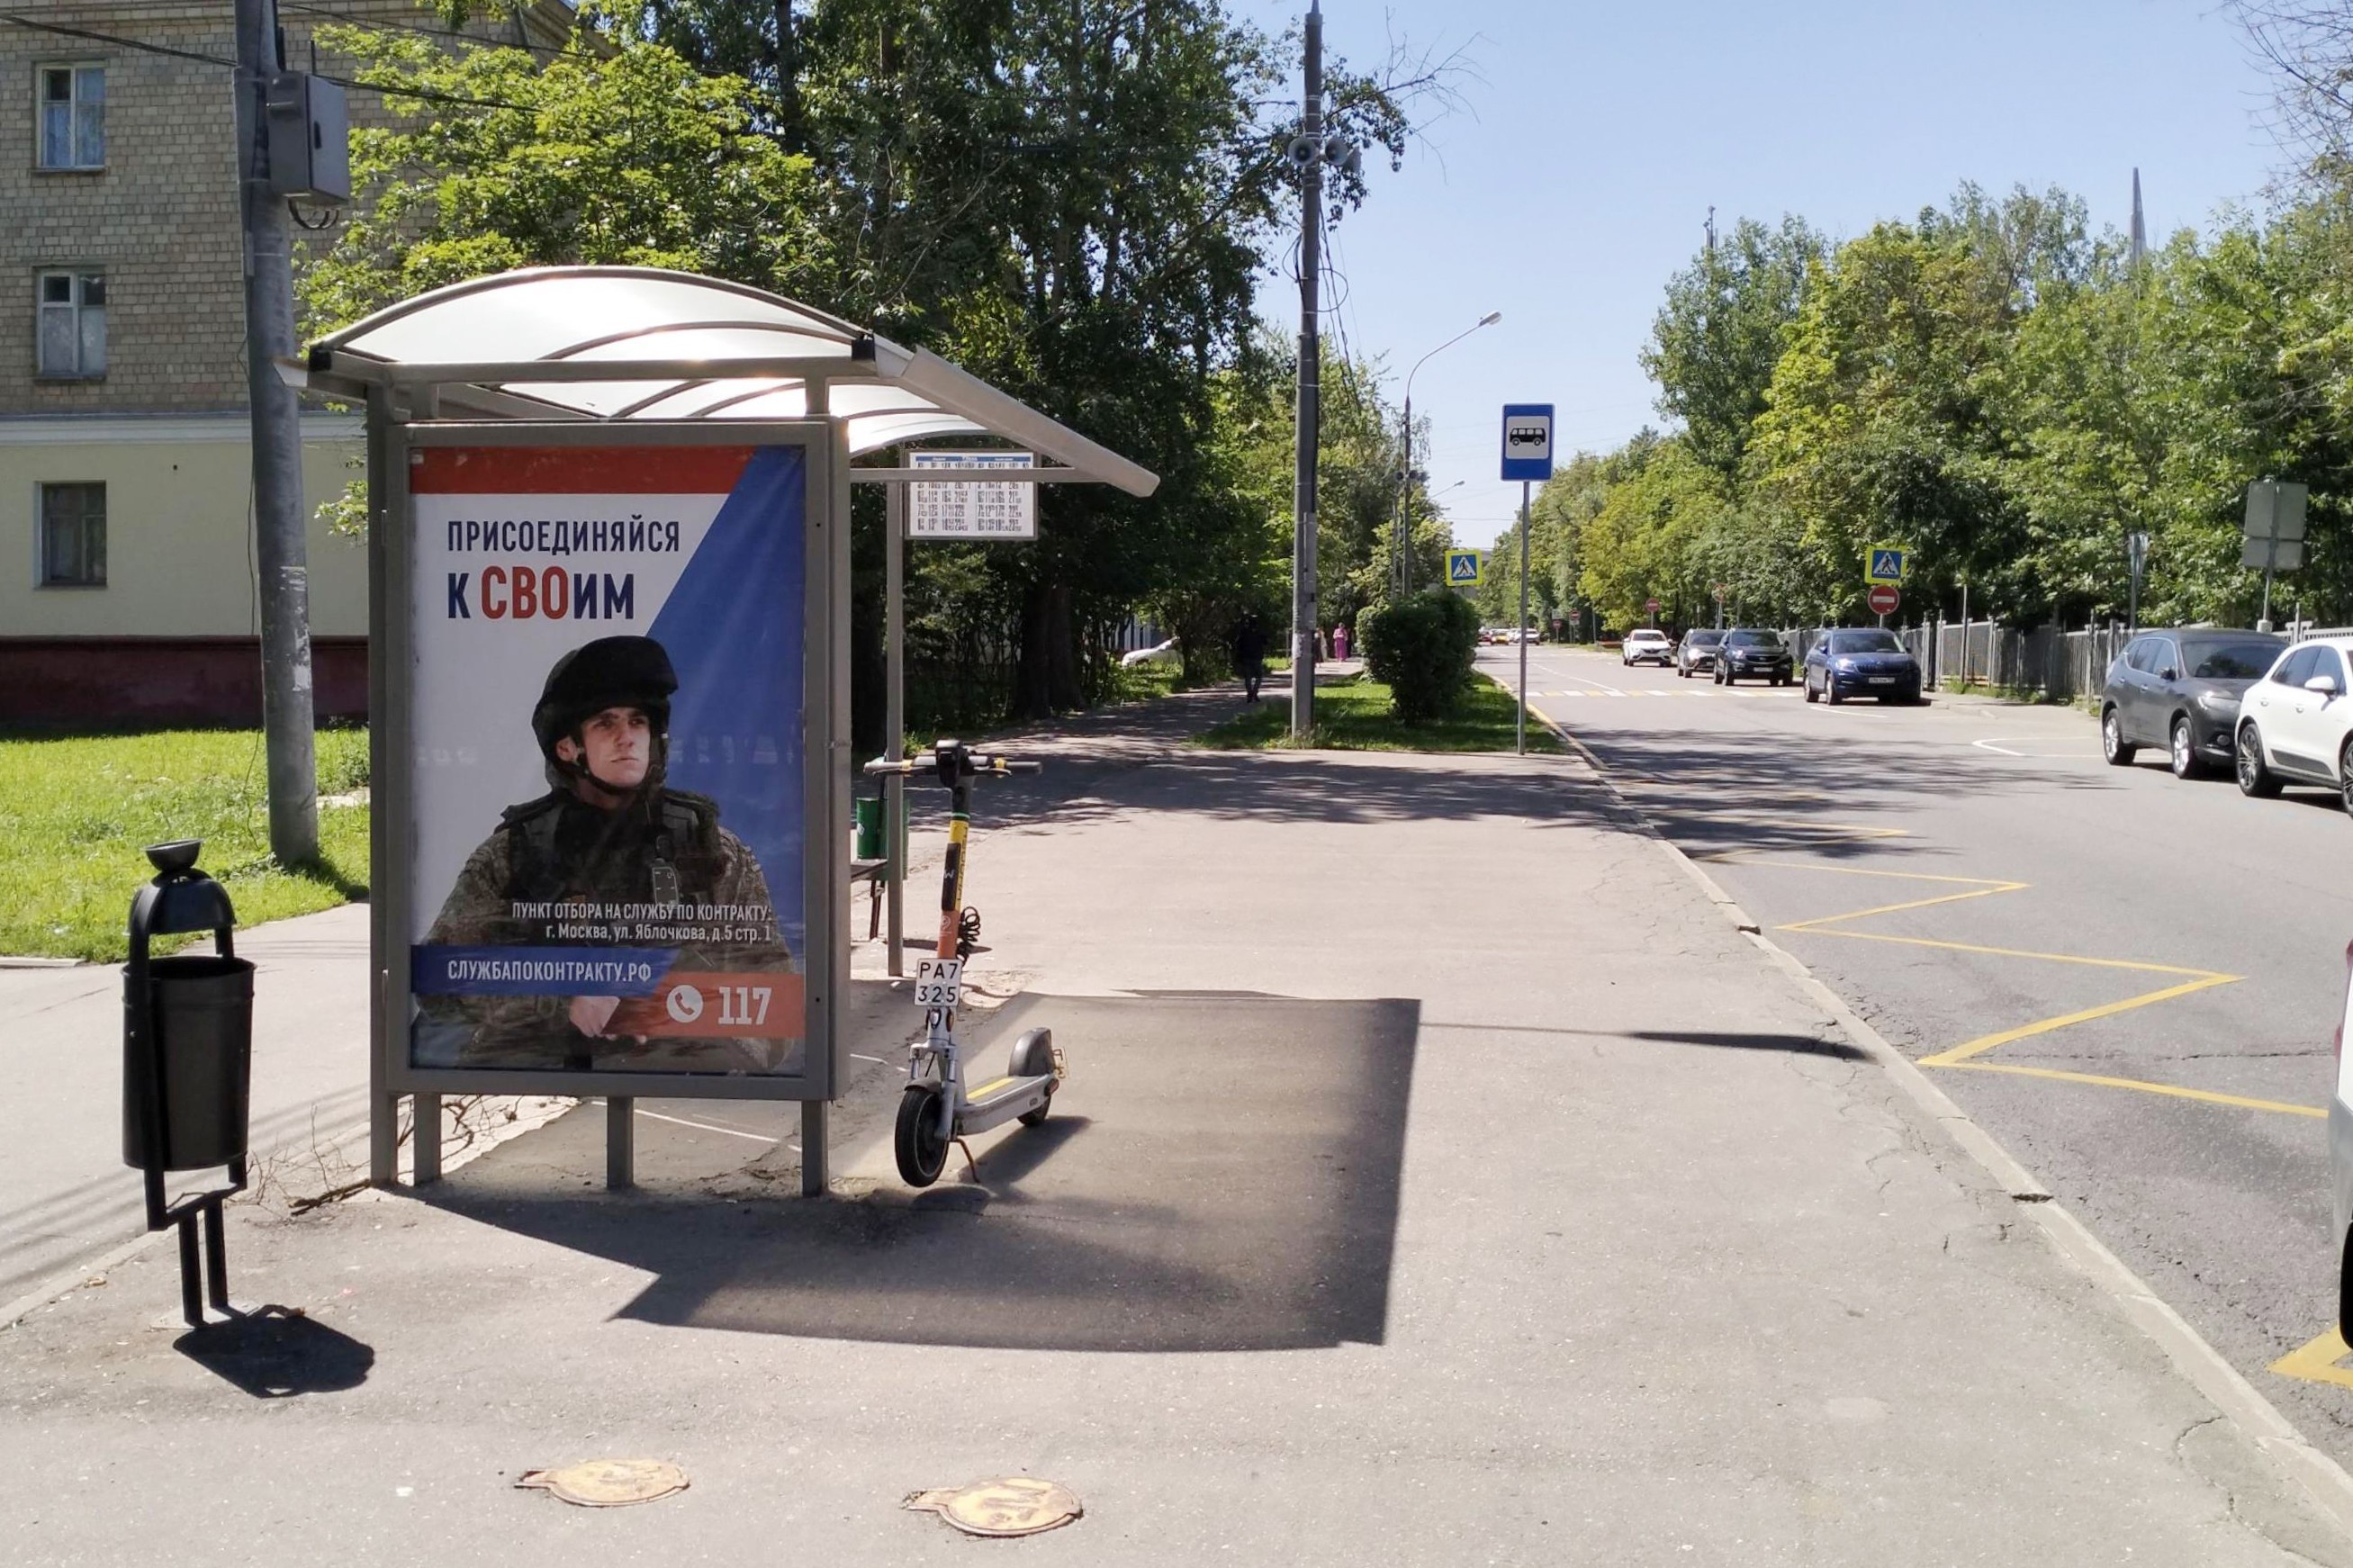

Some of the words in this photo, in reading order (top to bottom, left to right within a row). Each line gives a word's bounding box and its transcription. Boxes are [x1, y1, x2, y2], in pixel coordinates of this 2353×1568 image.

[447, 514, 680, 555] ПРИСОЕДИНЯЙСЯ
[512, 902, 552, 919] ПУНКТ
[554, 903, 602, 920] ОТБОРА
[605, 903, 621, 919] НА
[623, 903, 673, 921] СЛУЖБУ
[677, 904, 694, 921] ПО
[698, 905, 771, 922] КОНТРАКТУ:
[545, 925, 555, 938] г.
[558, 923, 611, 941] Москва,
[613, 925, 632, 942] ул.
[636, 924, 710, 942] Яблочкова,
[735, 927, 762, 944] стр.
[764, 925, 771, 941] 1
[448, 960, 652, 983] СЛУЖБАПОКОНТРАКТУ.РФ
[718, 986, 772, 1024] 117
[918, 986, 956, 1003] 325
